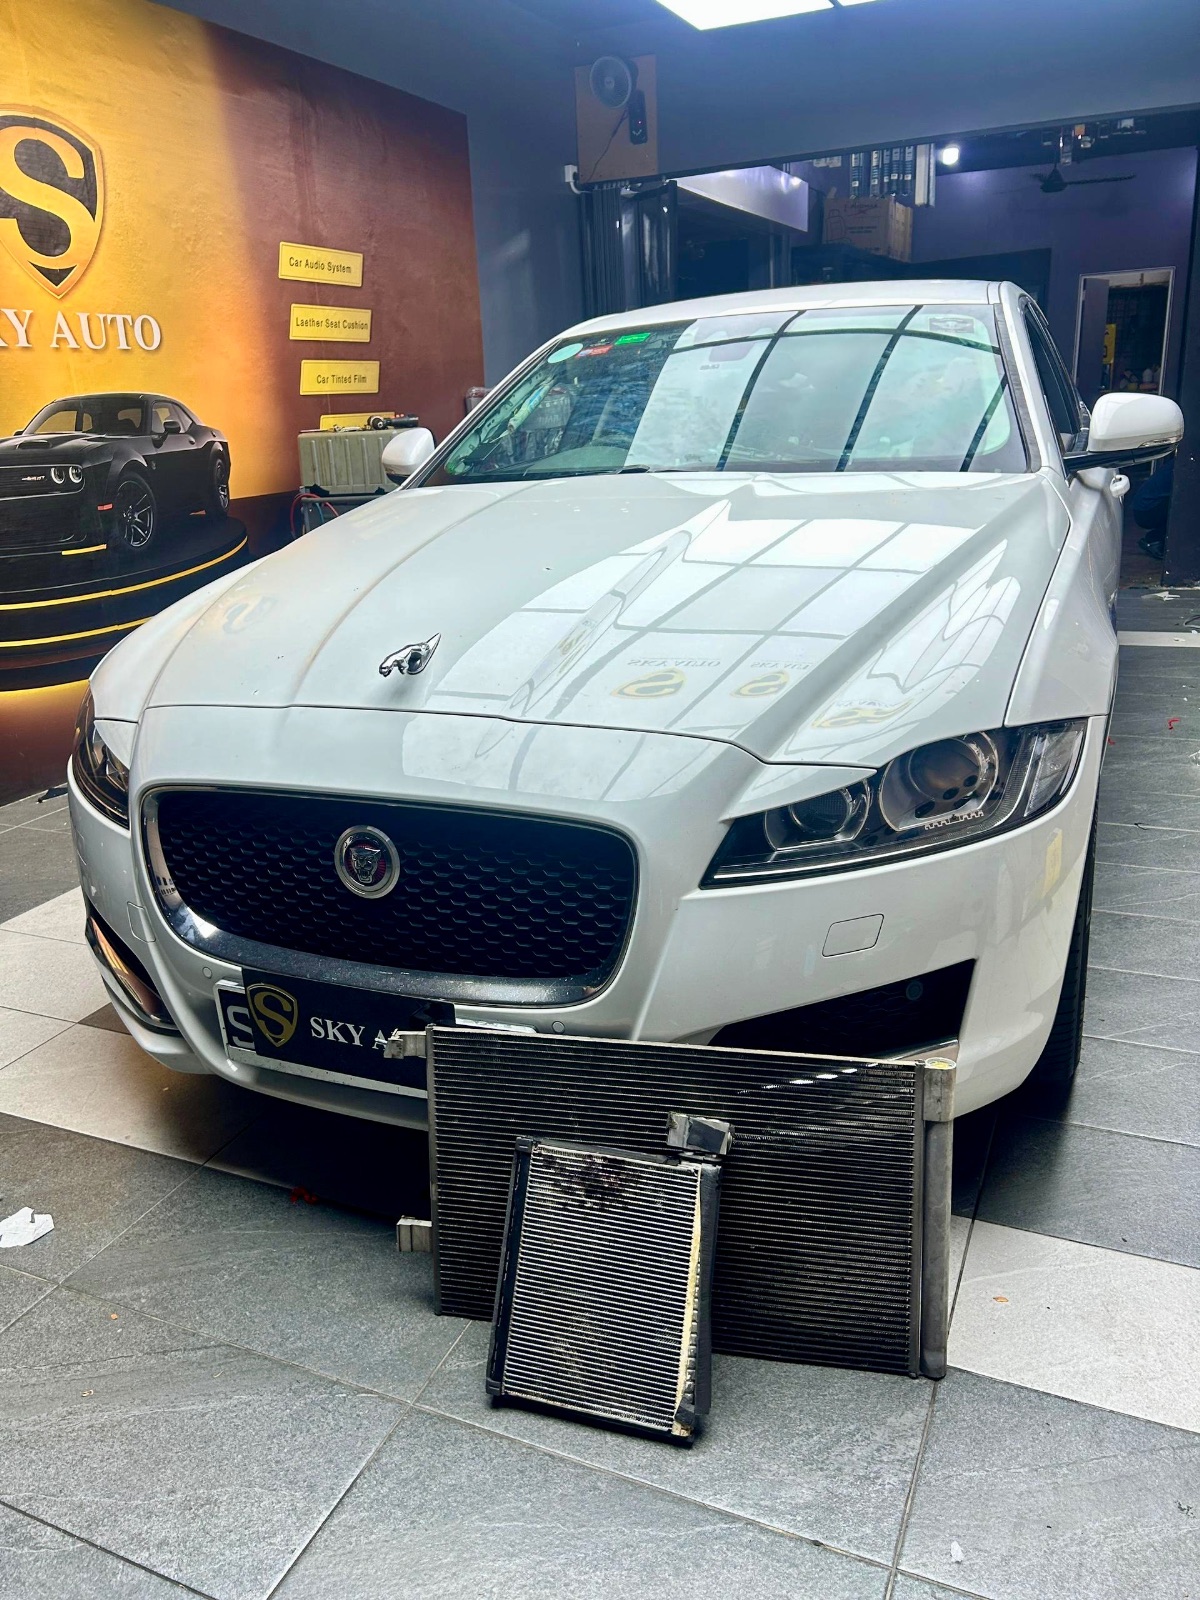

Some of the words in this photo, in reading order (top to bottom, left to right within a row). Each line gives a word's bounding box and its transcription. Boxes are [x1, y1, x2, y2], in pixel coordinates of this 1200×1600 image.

[289, 256, 302, 268] Car
[304, 259, 325, 271] Audio
[327, 261, 352, 274] System
[49, 310, 162, 351] AUTO
[295, 316, 324, 328] Laether
[325, 318, 341, 329] Seat
[342, 320, 368, 330] Cushion
[316, 374, 329, 384] Car
[331, 374, 352, 384] Tinted
[353, 374, 367, 384] Film
[254, 991, 293, 1040] S
[309, 1016, 366, 1047] SKY
